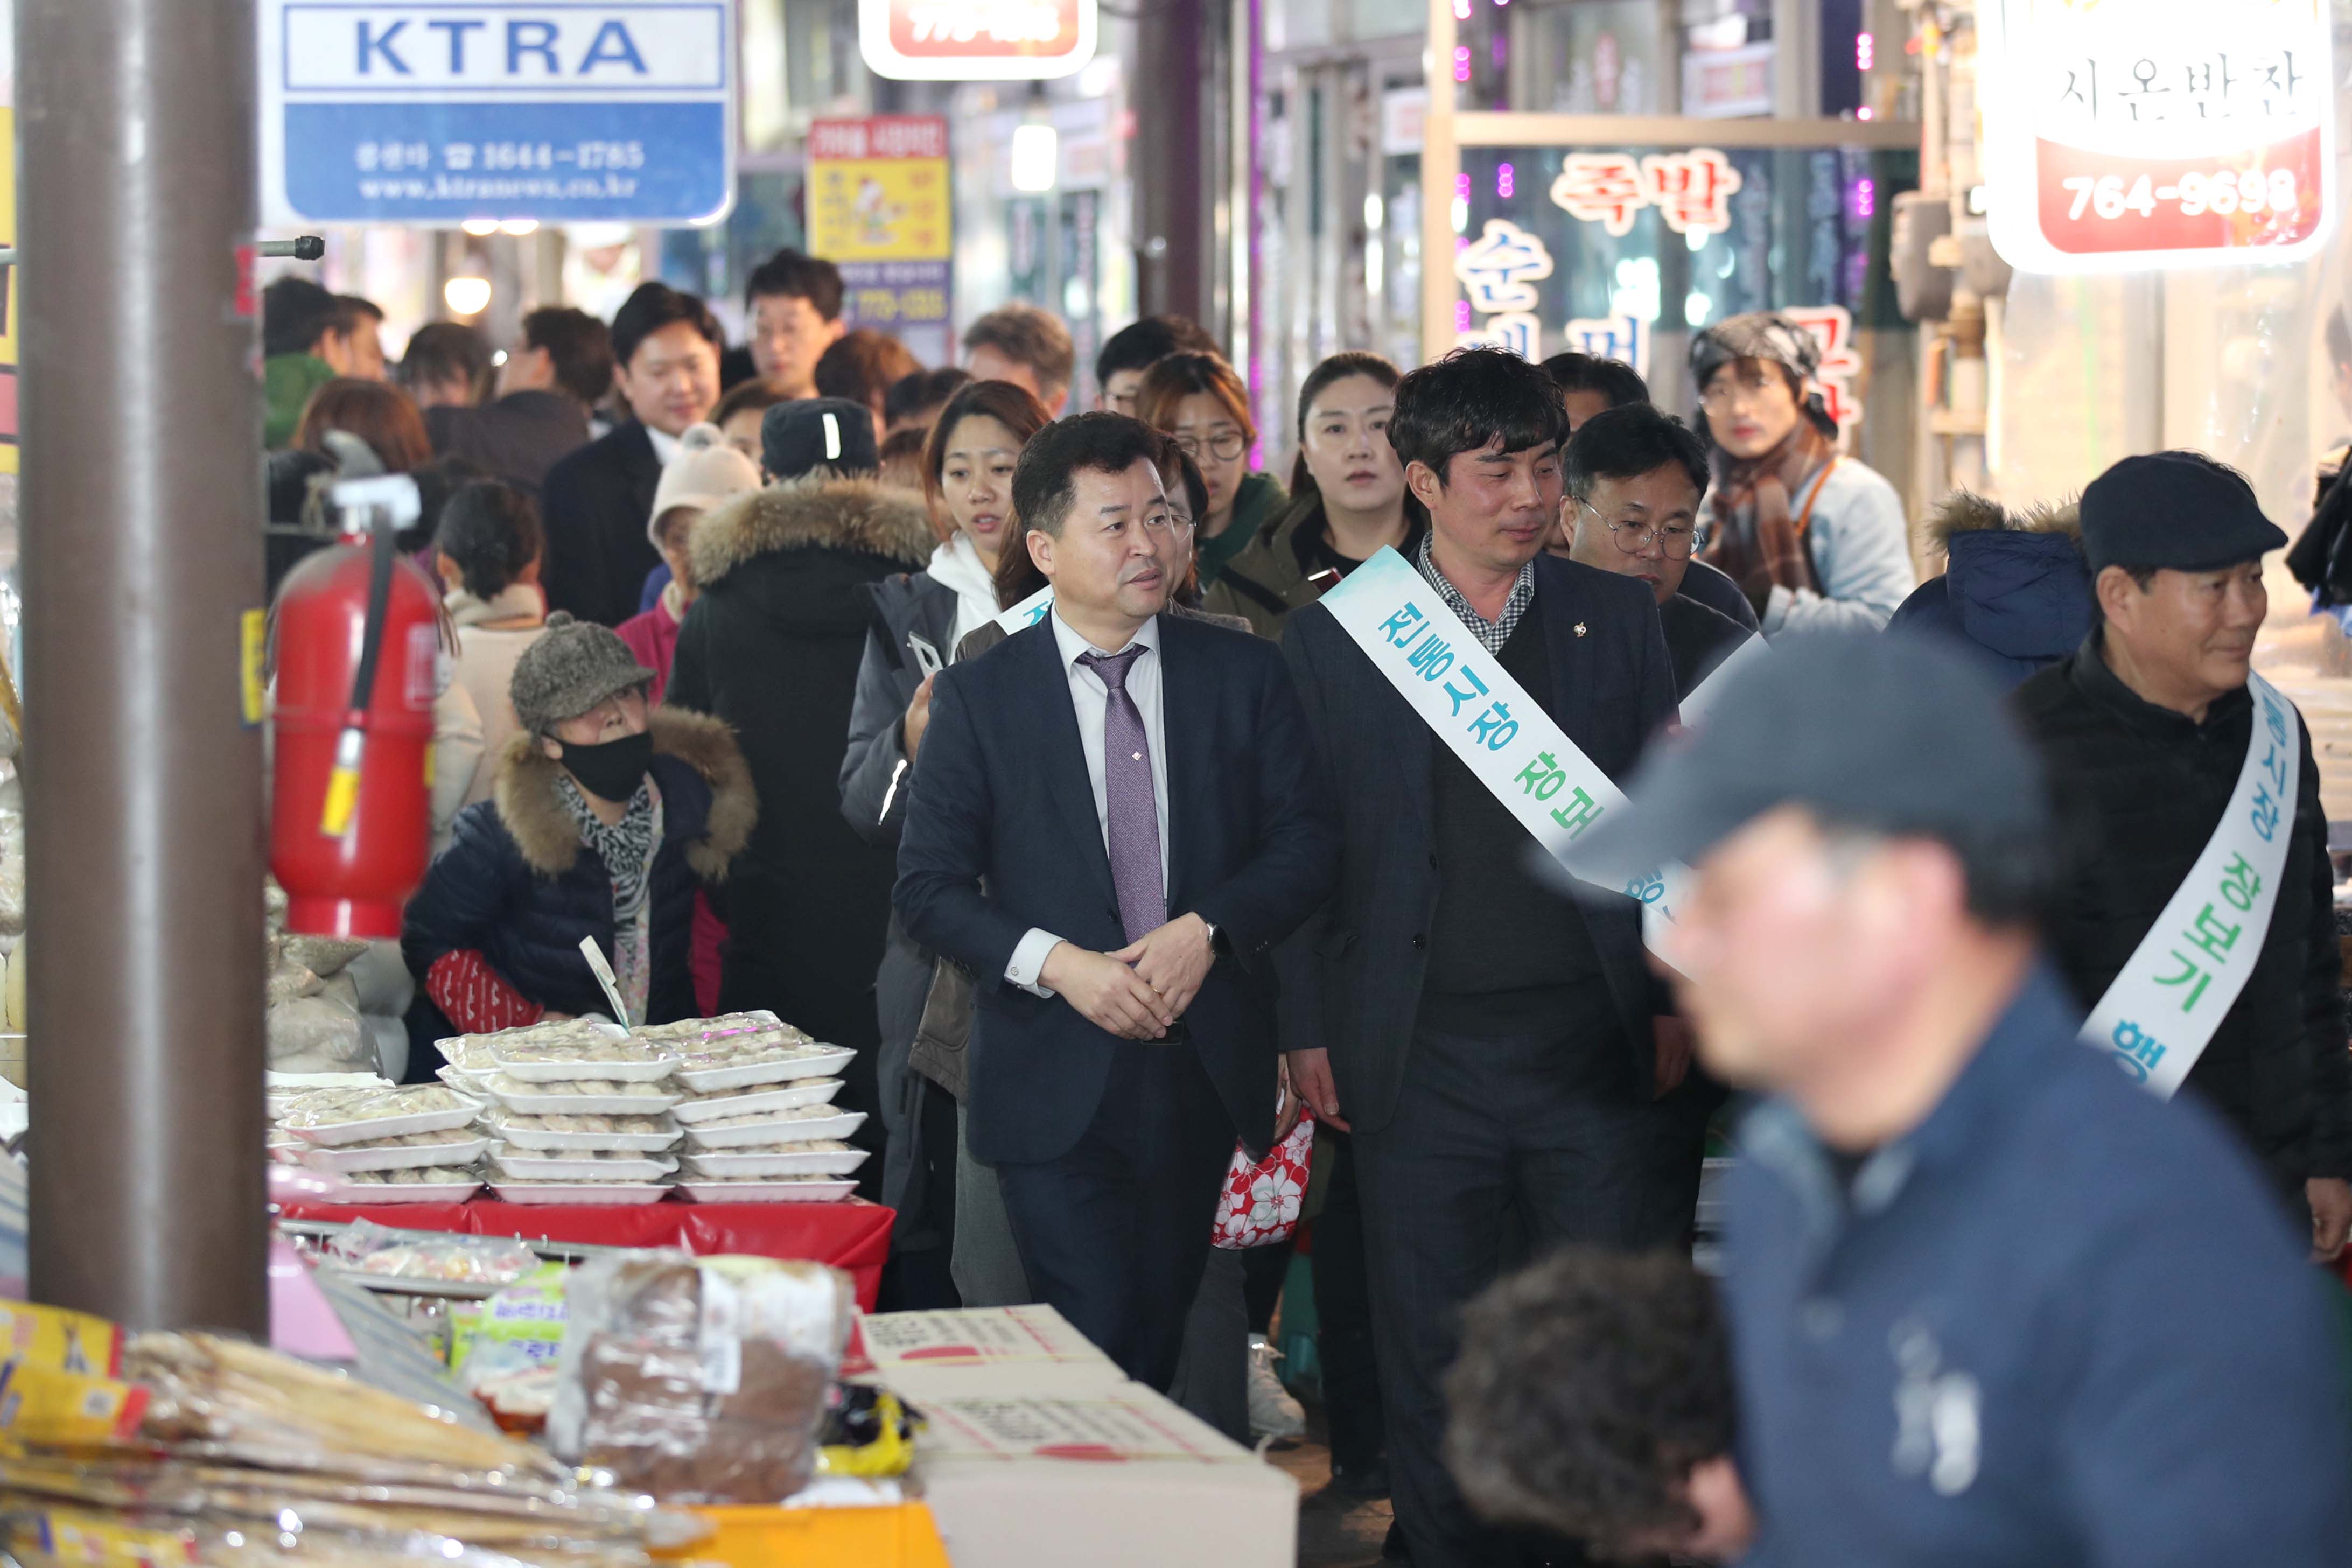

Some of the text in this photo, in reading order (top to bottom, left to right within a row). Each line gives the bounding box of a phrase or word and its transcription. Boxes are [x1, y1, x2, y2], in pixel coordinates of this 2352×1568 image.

[356, 19, 648, 75] KTRA
[2060, 50, 2304, 121] 시온반찬
[1557, 153, 1737, 230] 족발
[2062, 168, 2297, 220] 764-9698
[1378, 601, 1520, 751] 전통시장
[1513, 750, 1605, 841] 장보
[2152, 851, 2262, 1013] 장보기
